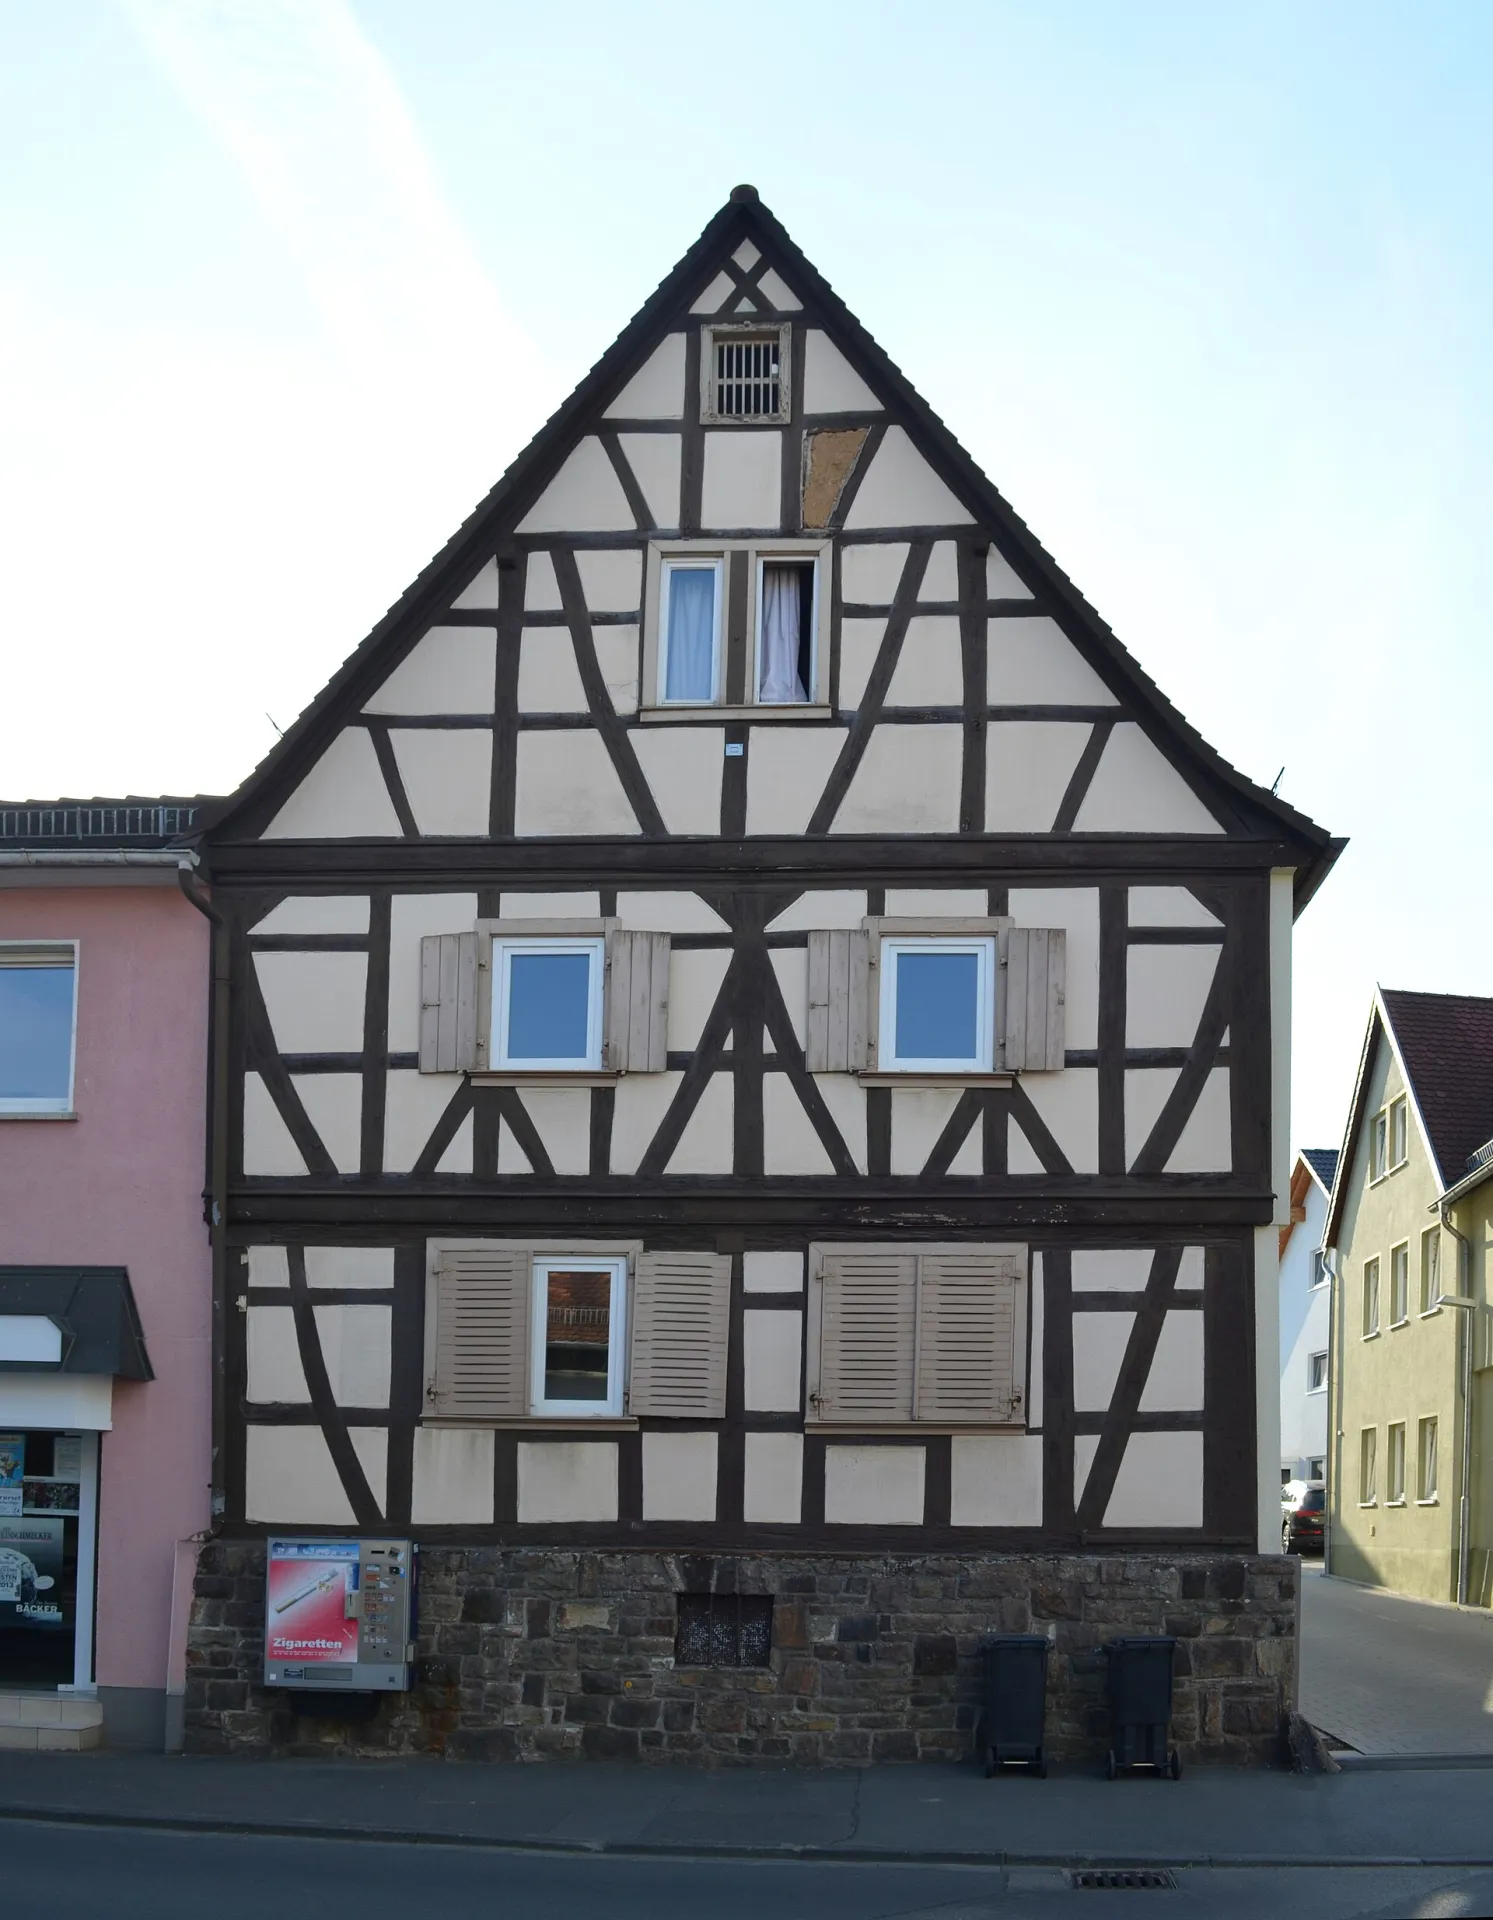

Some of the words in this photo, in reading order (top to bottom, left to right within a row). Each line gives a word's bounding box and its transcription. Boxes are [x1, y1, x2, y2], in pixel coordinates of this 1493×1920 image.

[0, 1531, 52, 1540] EINSCHMECKER
[16, 1602, 58, 1613] BÄCKER
[273, 1638, 342, 1650] Zigaretten
